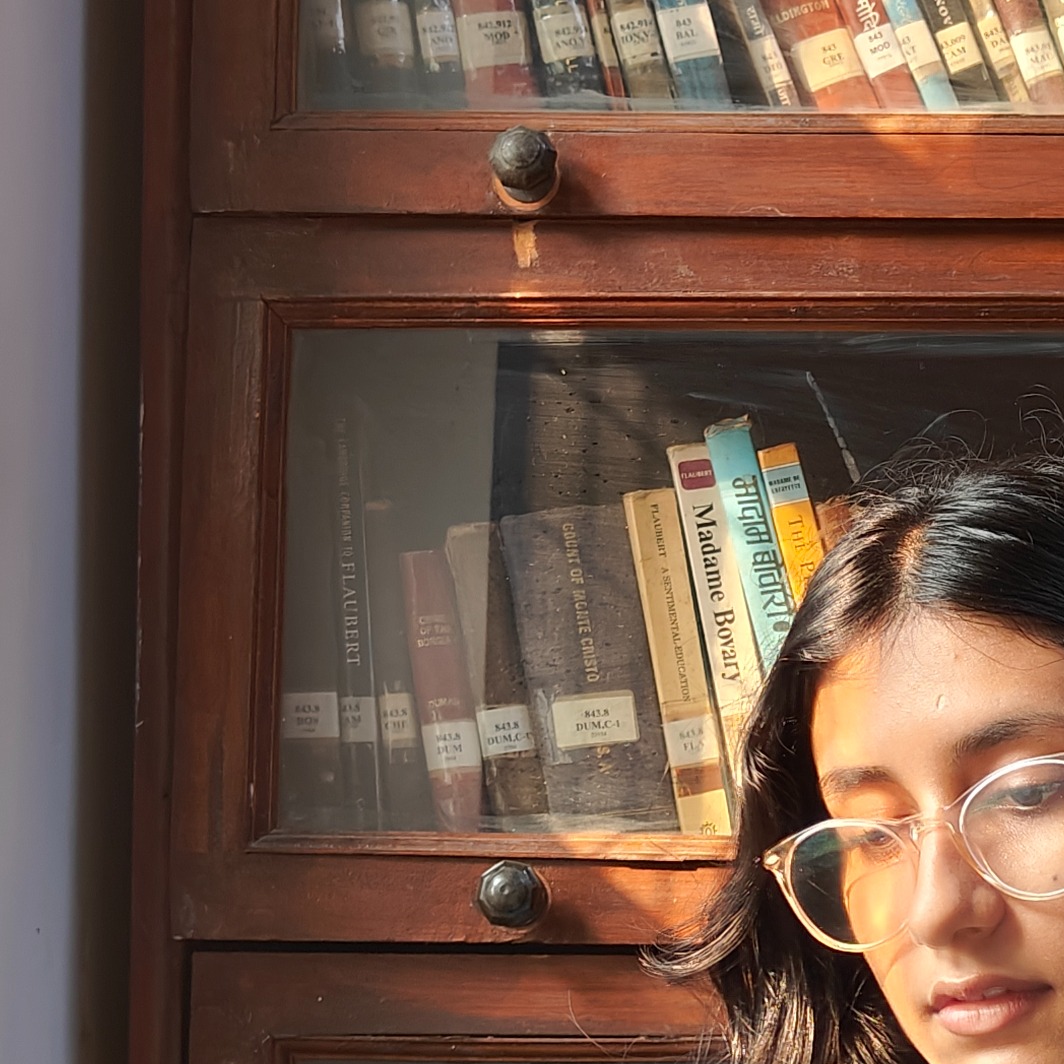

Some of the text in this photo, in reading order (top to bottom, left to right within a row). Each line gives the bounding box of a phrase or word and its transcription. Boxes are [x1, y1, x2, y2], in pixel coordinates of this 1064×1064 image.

[676, 30, 698, 40] BAL
[732, 475, 772, 546] मादाम
[562, 523, 576, 563] COUNT
[569, 568, 585, 585] OF
[691, 503, 742, 683] Madame Bovary
[341, 561, 361, 667] FLAUBERT
[574, 590, 592, 633] MONTE
[650, 503, 667, 559] FLAUBERT
[661, 576, 682, 646] SENTIMENTAL
[673, 646, 692, 703] EDUCATION
[495, 721, 520, 732] 843.8
[584, 709, 610, 719] 843.8
